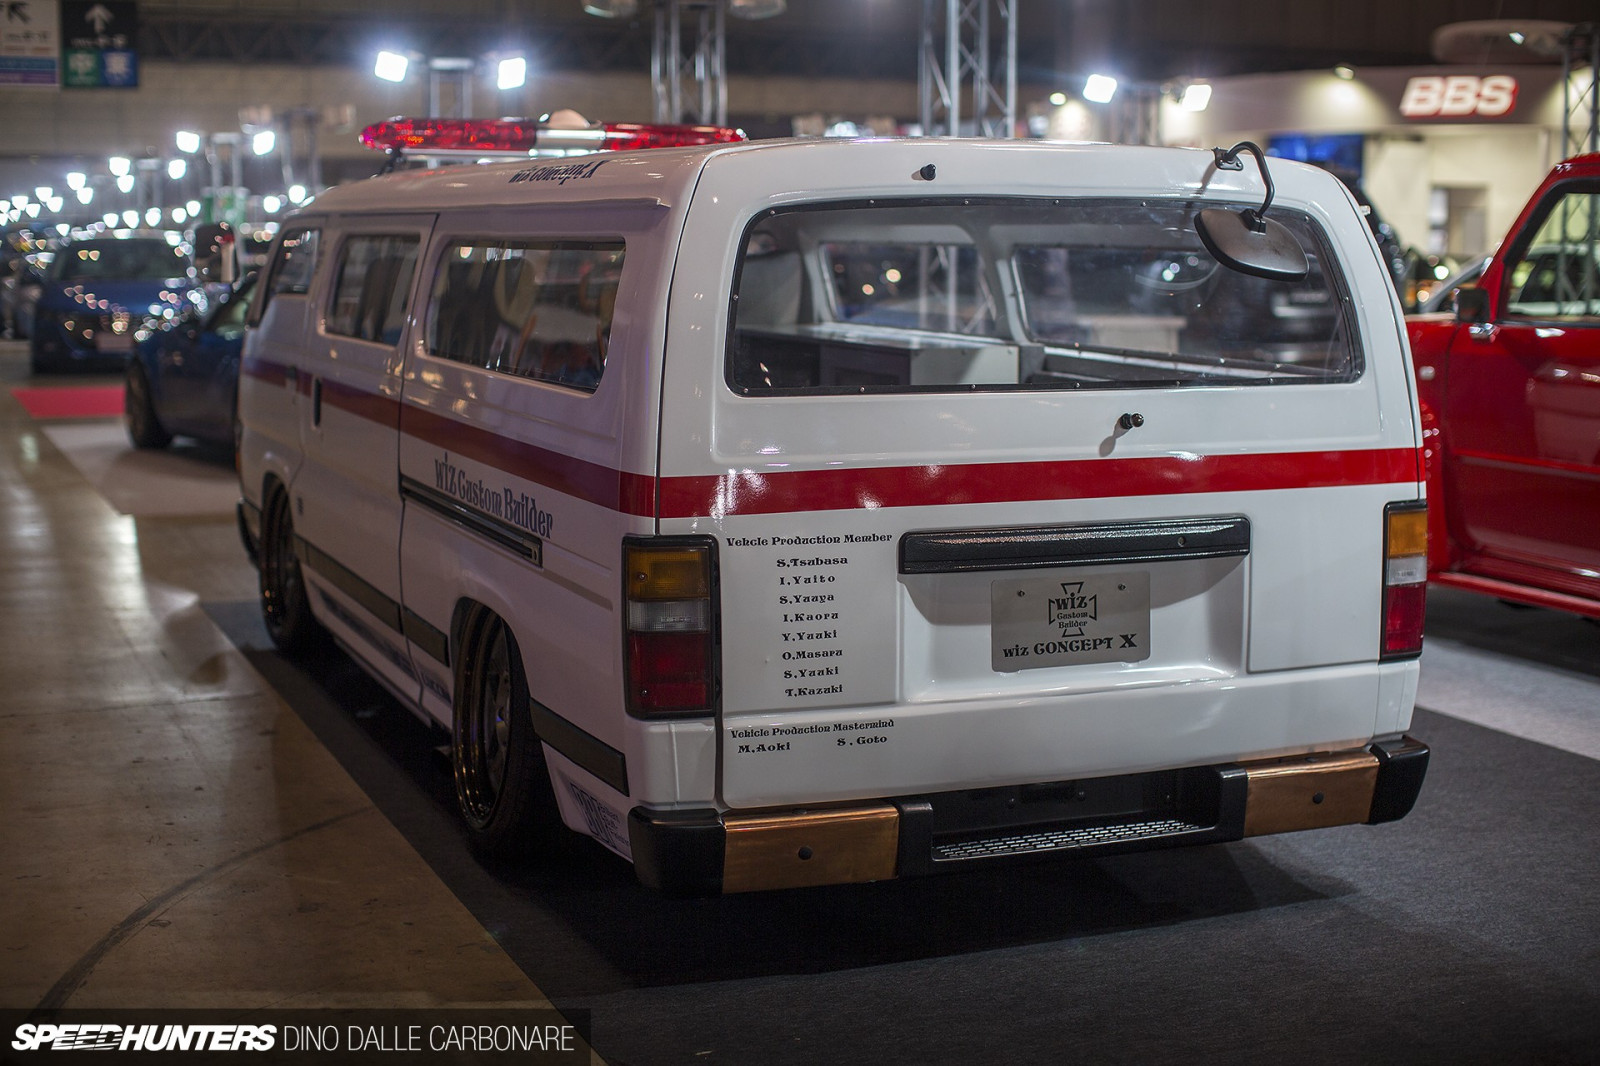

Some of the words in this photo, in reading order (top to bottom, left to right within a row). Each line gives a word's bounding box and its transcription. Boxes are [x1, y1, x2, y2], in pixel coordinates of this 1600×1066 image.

[1400, 75, 1519, 117] BBS
[434, 452, 456, 496] wiz
[457, 469, 502, 518] Custom
[503, 486, 553, 540] Builder
[771, 534, 841, 546] Production
[843, 533, 893, 544] Member
[1054, 592, 1088, 611] wiz
[1058, 619, 1088, 629] Builder
[1003, 644, 1029, 658] wiz
[1033, 637, 1114, 656] CONCEPT
[1119, 633, 1138, 649] X
[730, 728, 770, 739] Vehicle
[771, 724, 831, 736] Production
[832, 719, 895, 732] Mastermind
